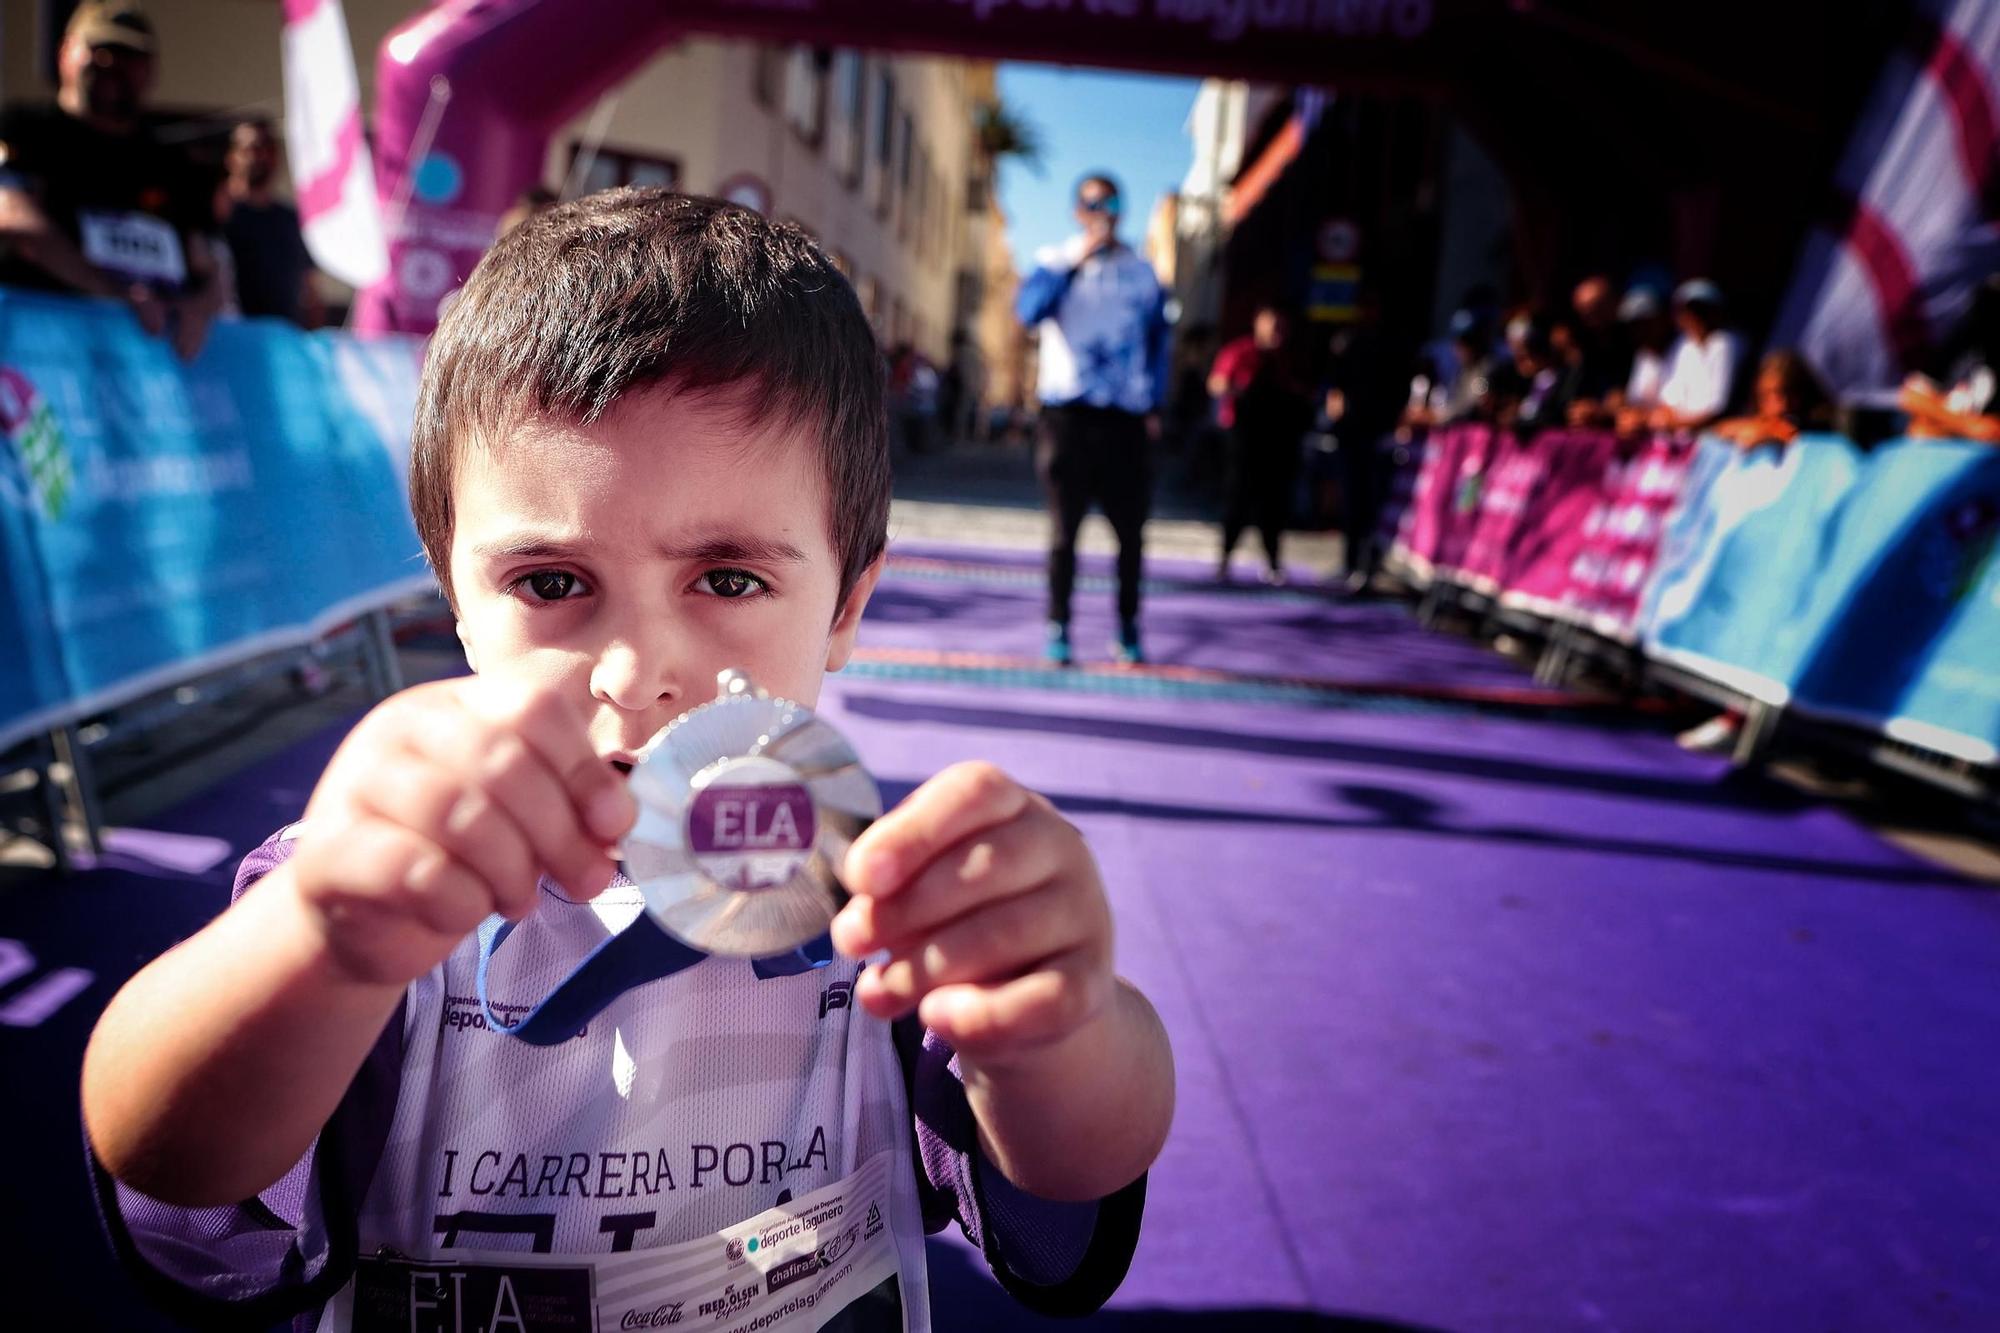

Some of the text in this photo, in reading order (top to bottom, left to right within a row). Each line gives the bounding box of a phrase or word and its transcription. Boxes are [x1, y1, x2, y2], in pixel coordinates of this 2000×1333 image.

[711, 799, 802, 848] ELA
[470, 1147, 677, 1199] CARRERA
[690, 1141, 787, 1188] POR
[760, 1223, 801, 1250] deporte
[802, 1203, 844, 1232] lagunero
